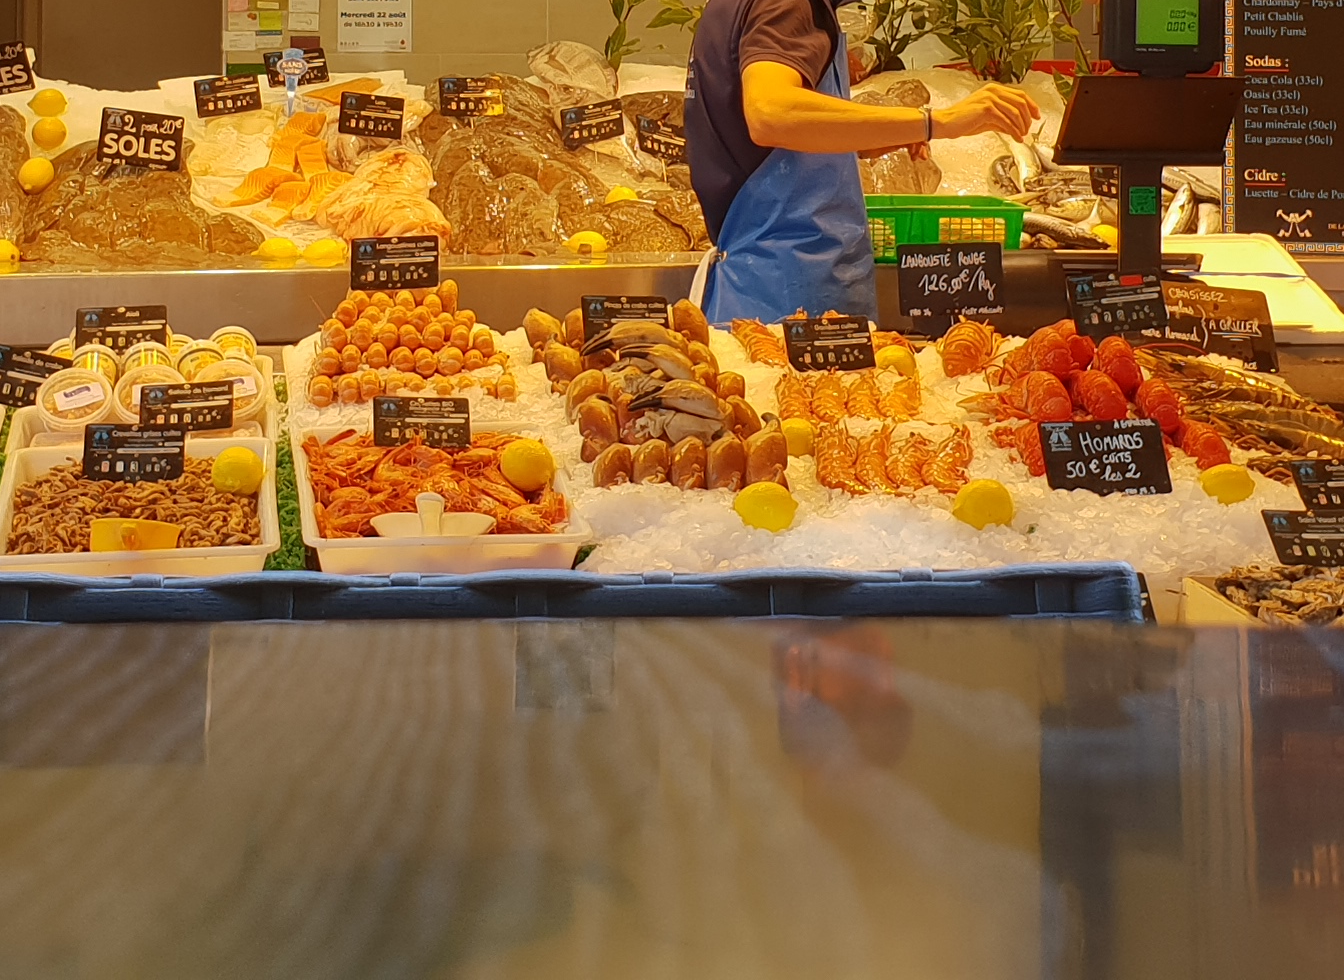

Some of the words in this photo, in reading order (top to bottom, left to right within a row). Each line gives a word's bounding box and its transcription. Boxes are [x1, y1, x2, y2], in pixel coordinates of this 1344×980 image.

[1245, 12, 1265, 20] Petit
[1268, 12, 1303, 21] Chablis
[1245, 26, 1277, 37] Pouilly
[1281, 27, 1306, 36] Fumé
[1246, 55, 1281, 67] Sodas
[1244, 75, 1268, 84] Coca
[1271, 75, 1292, 84] Cola
[1295, 76, 1323, 86] (33cl)
[1244, 90, 1270, 99] Oasis
[1273, 90, 1300, 100] (33cl)
[1245, 104, 1258, 113] Ice
[1261, 105, 1277, 114] Tea
[1280, 105, 1308, 115] (33cl)
[123, 115, 136, 132] 2
[1245, 119, 1262, 128] Eau
[1266, 120, 1306, 129] minérale
[1309, 120, 1336, 131] (50cl)
[1245, 134, 1262, 143] Eau
[1265, 137, 1302, 146] gazeuse
[1305, 135, 1332, 146] (50cl)
[103, 133, 176, 161] SOLES
[1244, 169, 1278, 181] Cidre
[1245, 188, 1278, 197] Lucette
[1290, 189, 1314, 198] Cidre
[1318, 190, 1328, 198] de
[901, 254, 951, 268] LANGOUSTE
[958, 251, 986, 266] ROUGE
[1219, 318, 1262, 334] GRILLER
[1079, 431, 1143, 456] HOMARDS
[1102, 451, 1132, 464] CUITS
[1066, 461, 1086, 478] 50
[1089, 459, 1100, 473] €
[1100, 465, 1123, 481] les
[1125, 463, 1141, 479] 2
